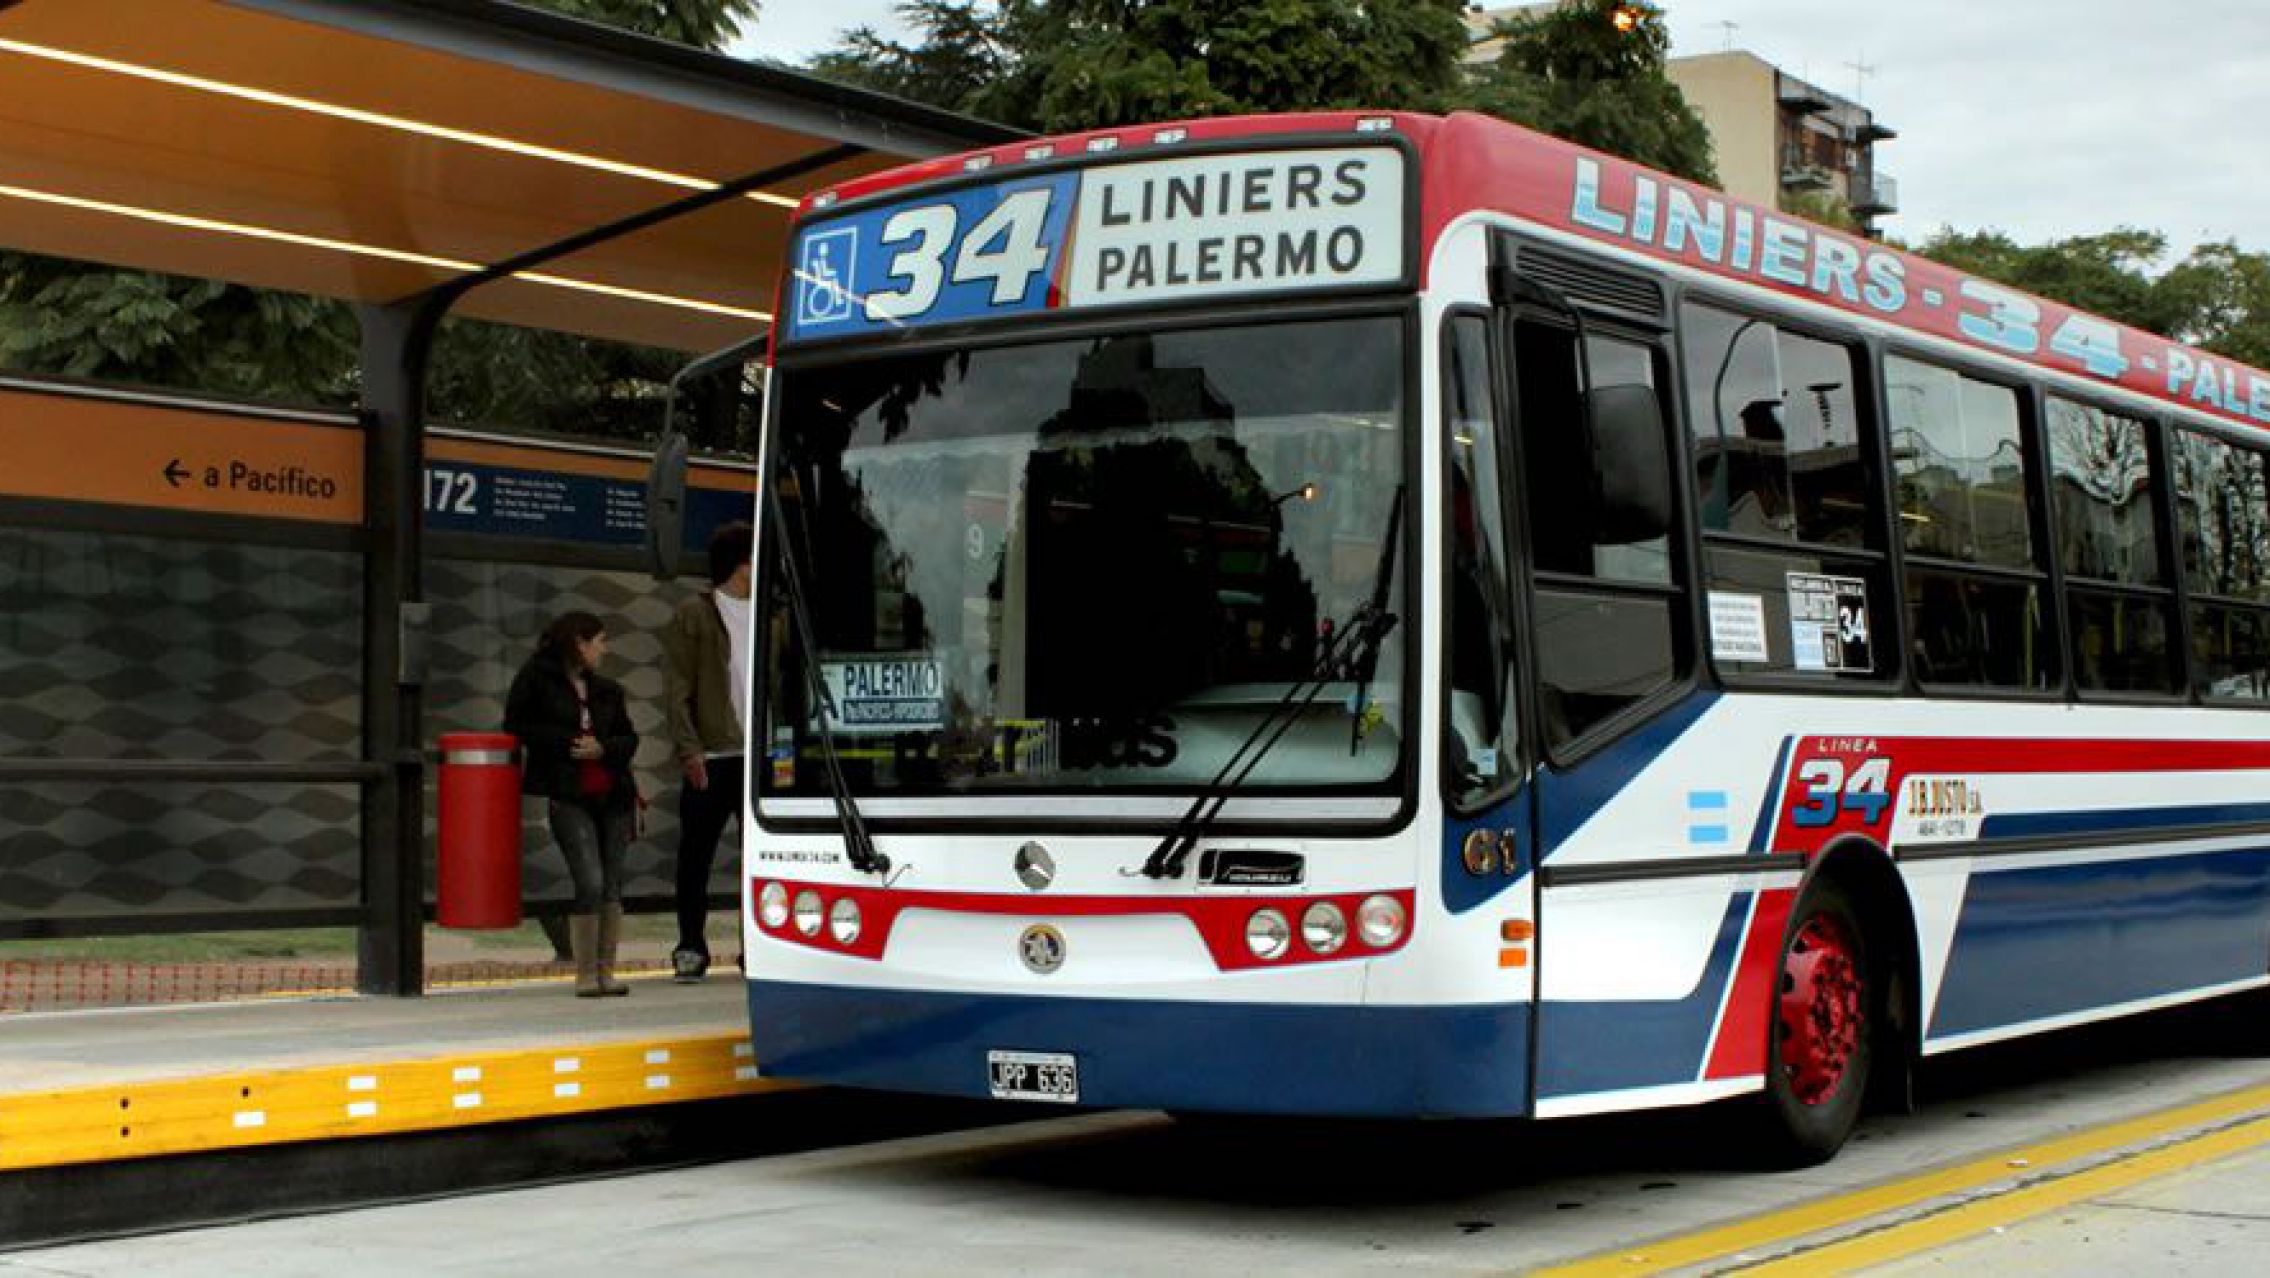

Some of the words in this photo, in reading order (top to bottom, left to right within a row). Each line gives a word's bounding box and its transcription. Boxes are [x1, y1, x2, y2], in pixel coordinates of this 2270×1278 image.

[1101, 160, 1368, 226] LINIERS
[864, 187, 1057, 320] 34
[1098, 224, 1364, 291] PALERMO
[1570, 154, 1907, 313] LINIERS
[1956, 277, 2129, 381] 34
[204, 466, 219, 488] a
[229, 459, 336, 499] Pacífico
[1839, 605, 1868, 643] 34
[845, 663, 938, 696] PALERMO
[1791, 757, 1893, 827] 34
[991, 1063, 1026, 1090] JPP
[1039, 1064, 1074, 1094] 636
